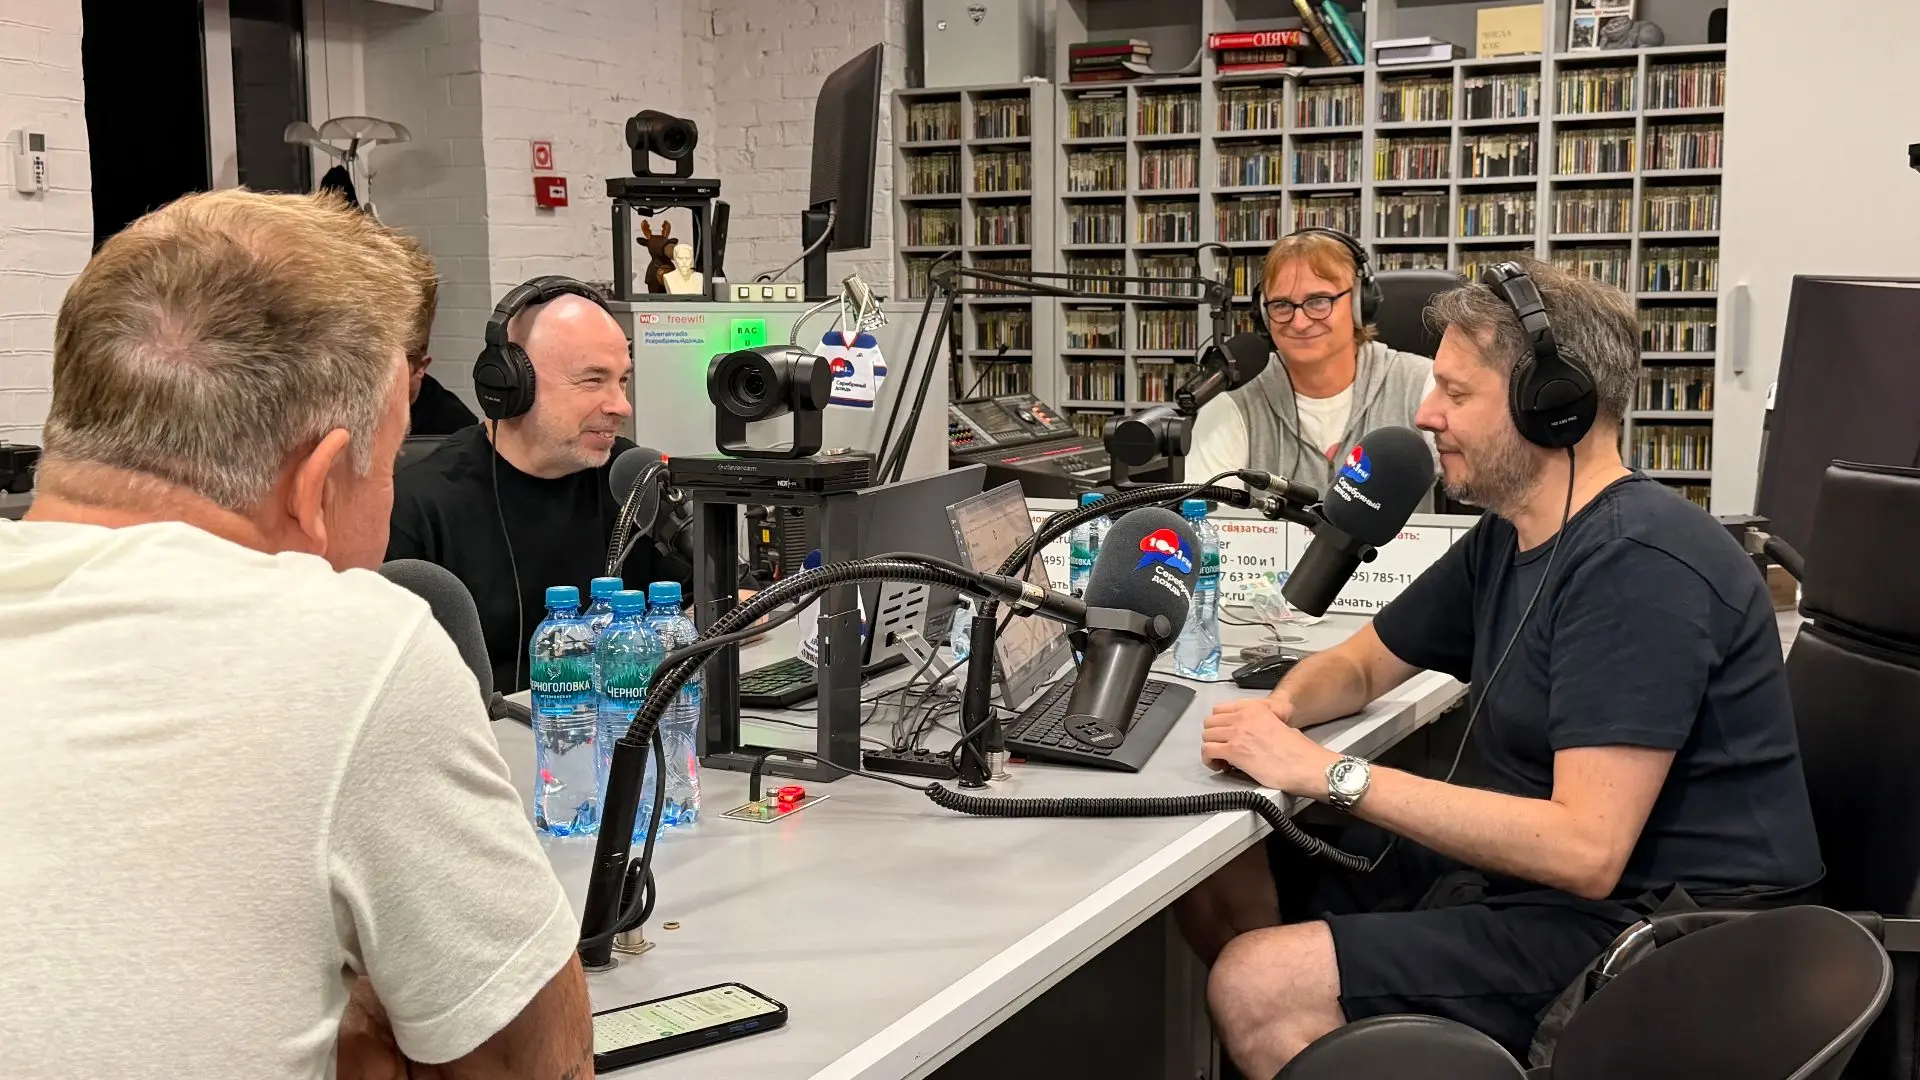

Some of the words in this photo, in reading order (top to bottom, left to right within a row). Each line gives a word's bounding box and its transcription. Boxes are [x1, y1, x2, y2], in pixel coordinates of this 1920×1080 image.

[1338, 476, 1382, 511] Серебряный
[1221, 524, 1279, 534] связаться:
[1237, 555, 1257, 565] 100
[1270, 557, 1275, 566] 1
